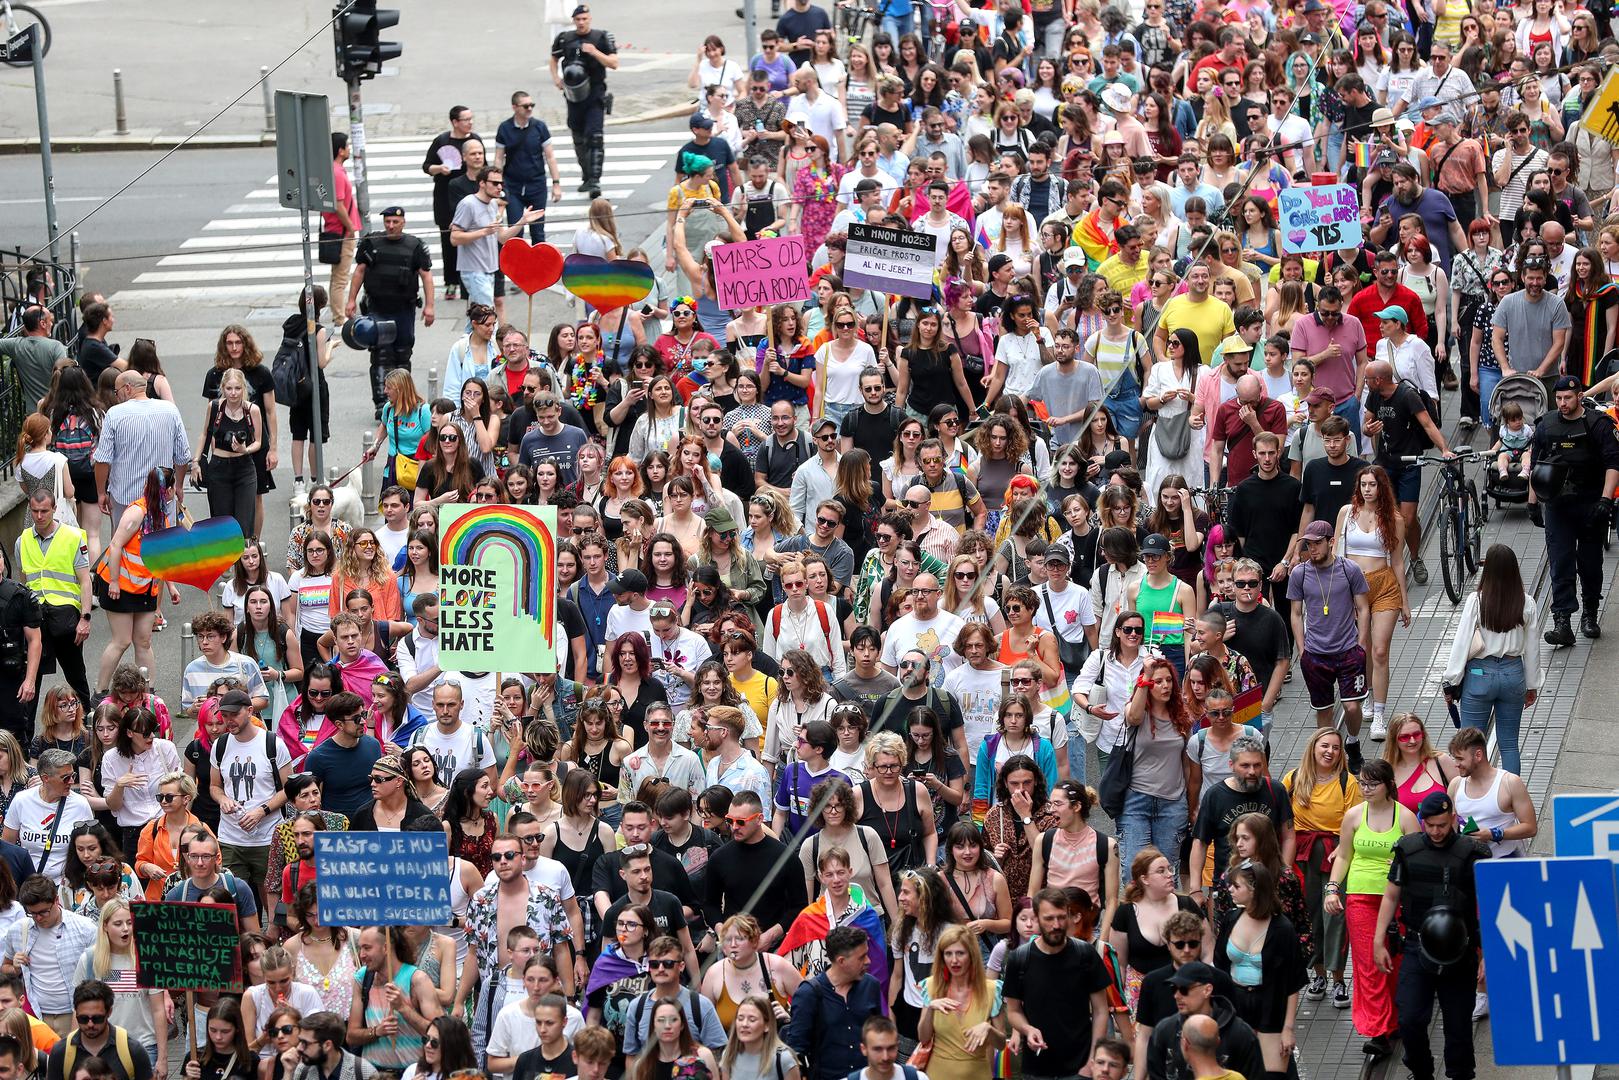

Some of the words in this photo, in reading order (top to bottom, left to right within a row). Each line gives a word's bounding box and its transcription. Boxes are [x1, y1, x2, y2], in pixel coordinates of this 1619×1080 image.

[854, 226, 865, 237] SA
[871, 231, 898, 242] MNOM
[901, 234, 931, 247] MOŽEŠ
[715, 243, 772, 275] MARŠ
[778, 240, 804, 268] OD
[860, 245, 888, 257] PRIČAT
[892, 250, 921, 262] PROSTO
[875, 263, 887, 271] NE
[888, 265, 913, 275] JEBEM
[723, 279, 769, 306] MOGA
[771, 277, 808, 301] RODA
[441, 568, 497, 589] MORE
[441, 588, 497, 609] LOVE
[441, 610, 495, 630] LESS
[441, 632, 495, 652] HATE
[389, 839, 406, 855] JE
[320, 858, 377, 877] ŠKARAC
[321, 885, 341, 899] NA
[344, 886, 380, 900] ULICI
[386, 885, 434, 901] PEDER
[439, 887, 448, 901] A
[336, 908, 378, 922] CRKVI
[157, 920, 208, 931] NULTE
[137, 932, 240, 947] TOLERANCIJE
[140, 944, 160, 957] NA
[166, 946, 231, 965] NASILJE
[141, 961, 220, 980] TOLERIRA
